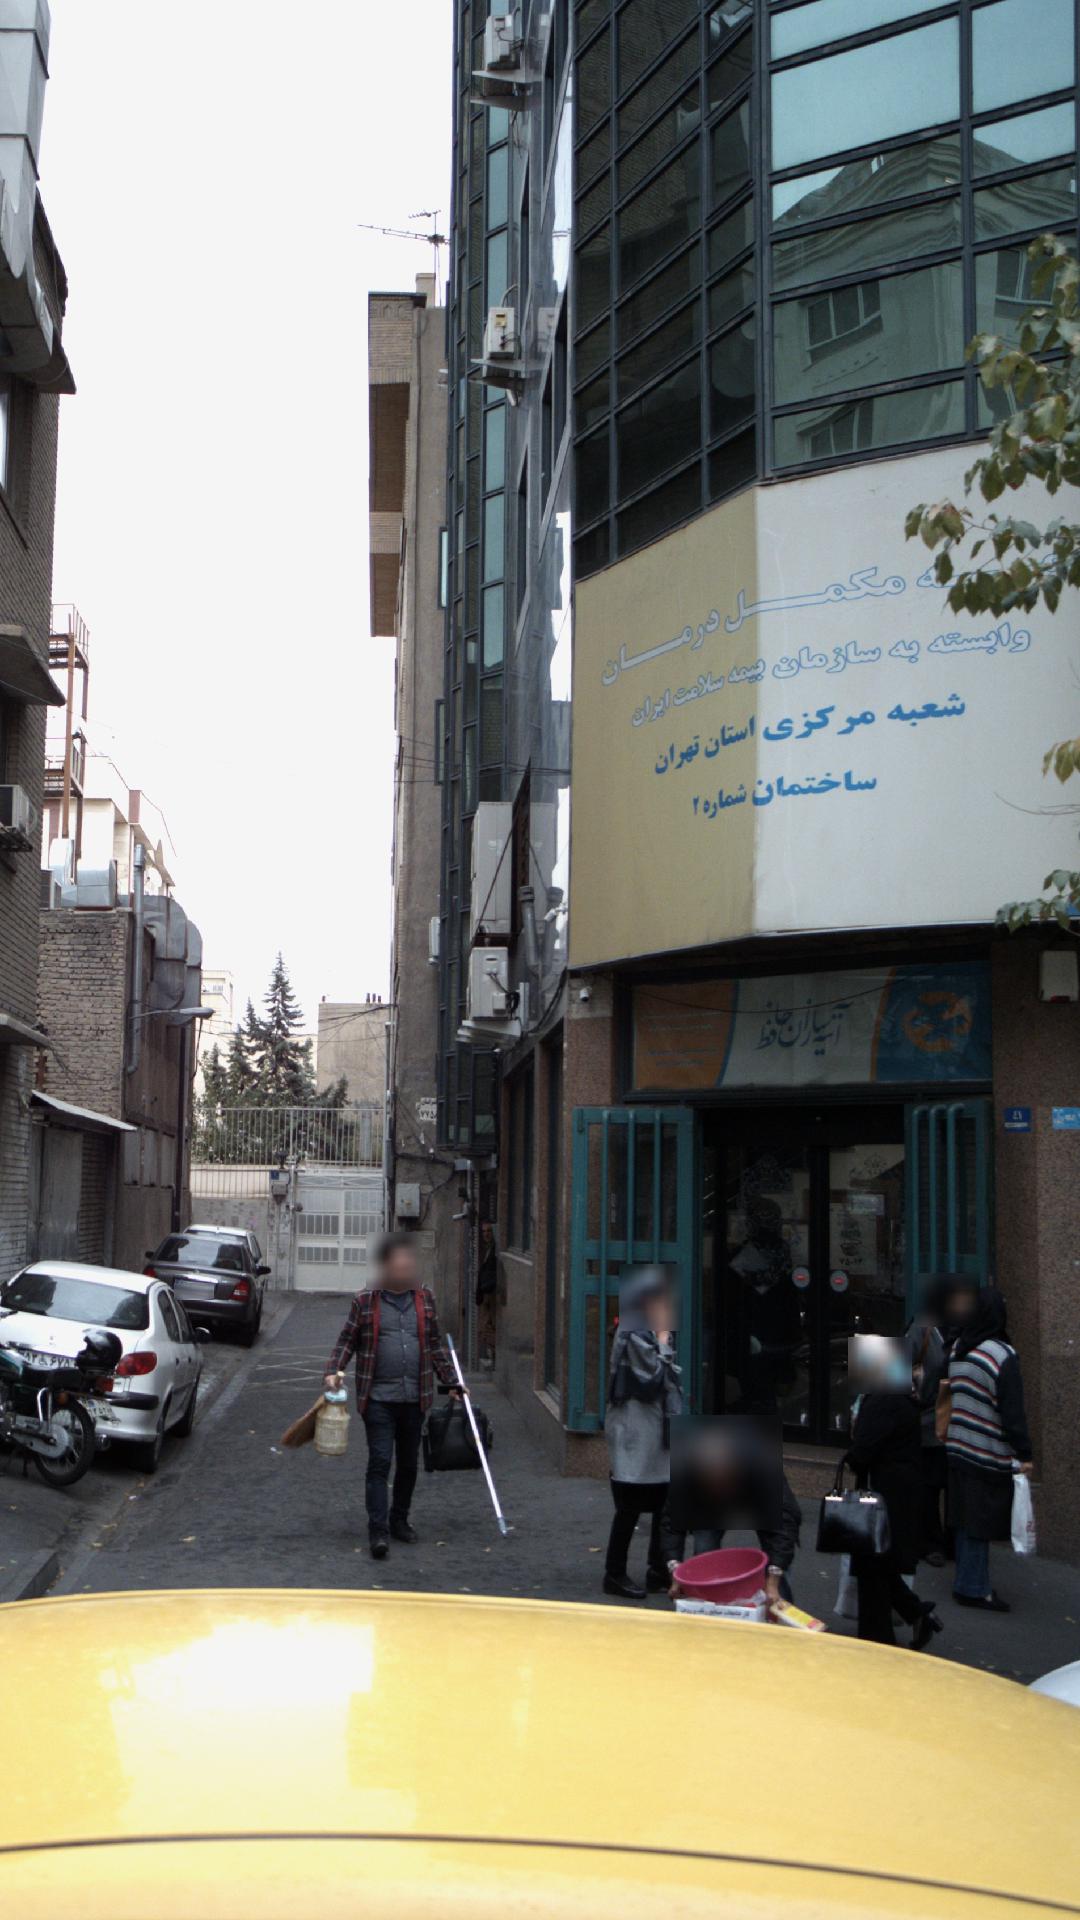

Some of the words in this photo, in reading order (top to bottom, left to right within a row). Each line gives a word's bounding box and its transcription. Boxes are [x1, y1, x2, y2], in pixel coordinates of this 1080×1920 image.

[724, 566, 906, 633] مکمل
[601, 608, 720, 686] درمان
[888, 640, 920, 663] به
[928, 622, 1031, 655] وابسته
[727, 659, 766, 683] بیمه
[771, 640, 881, 679] سازمان
[672, 672, 724, 706] سلامت
[632, 688, 671, 727] ایران
[763, 705, 876, 741] مرکزی
[887, 693, 966, 727] شعبه
[654, 735, 700, 774] تهران
[704, 715, 755, 758] استان
[703, 784, 747, 819] شماره
[752, 770, 877, 806] ساختمان
